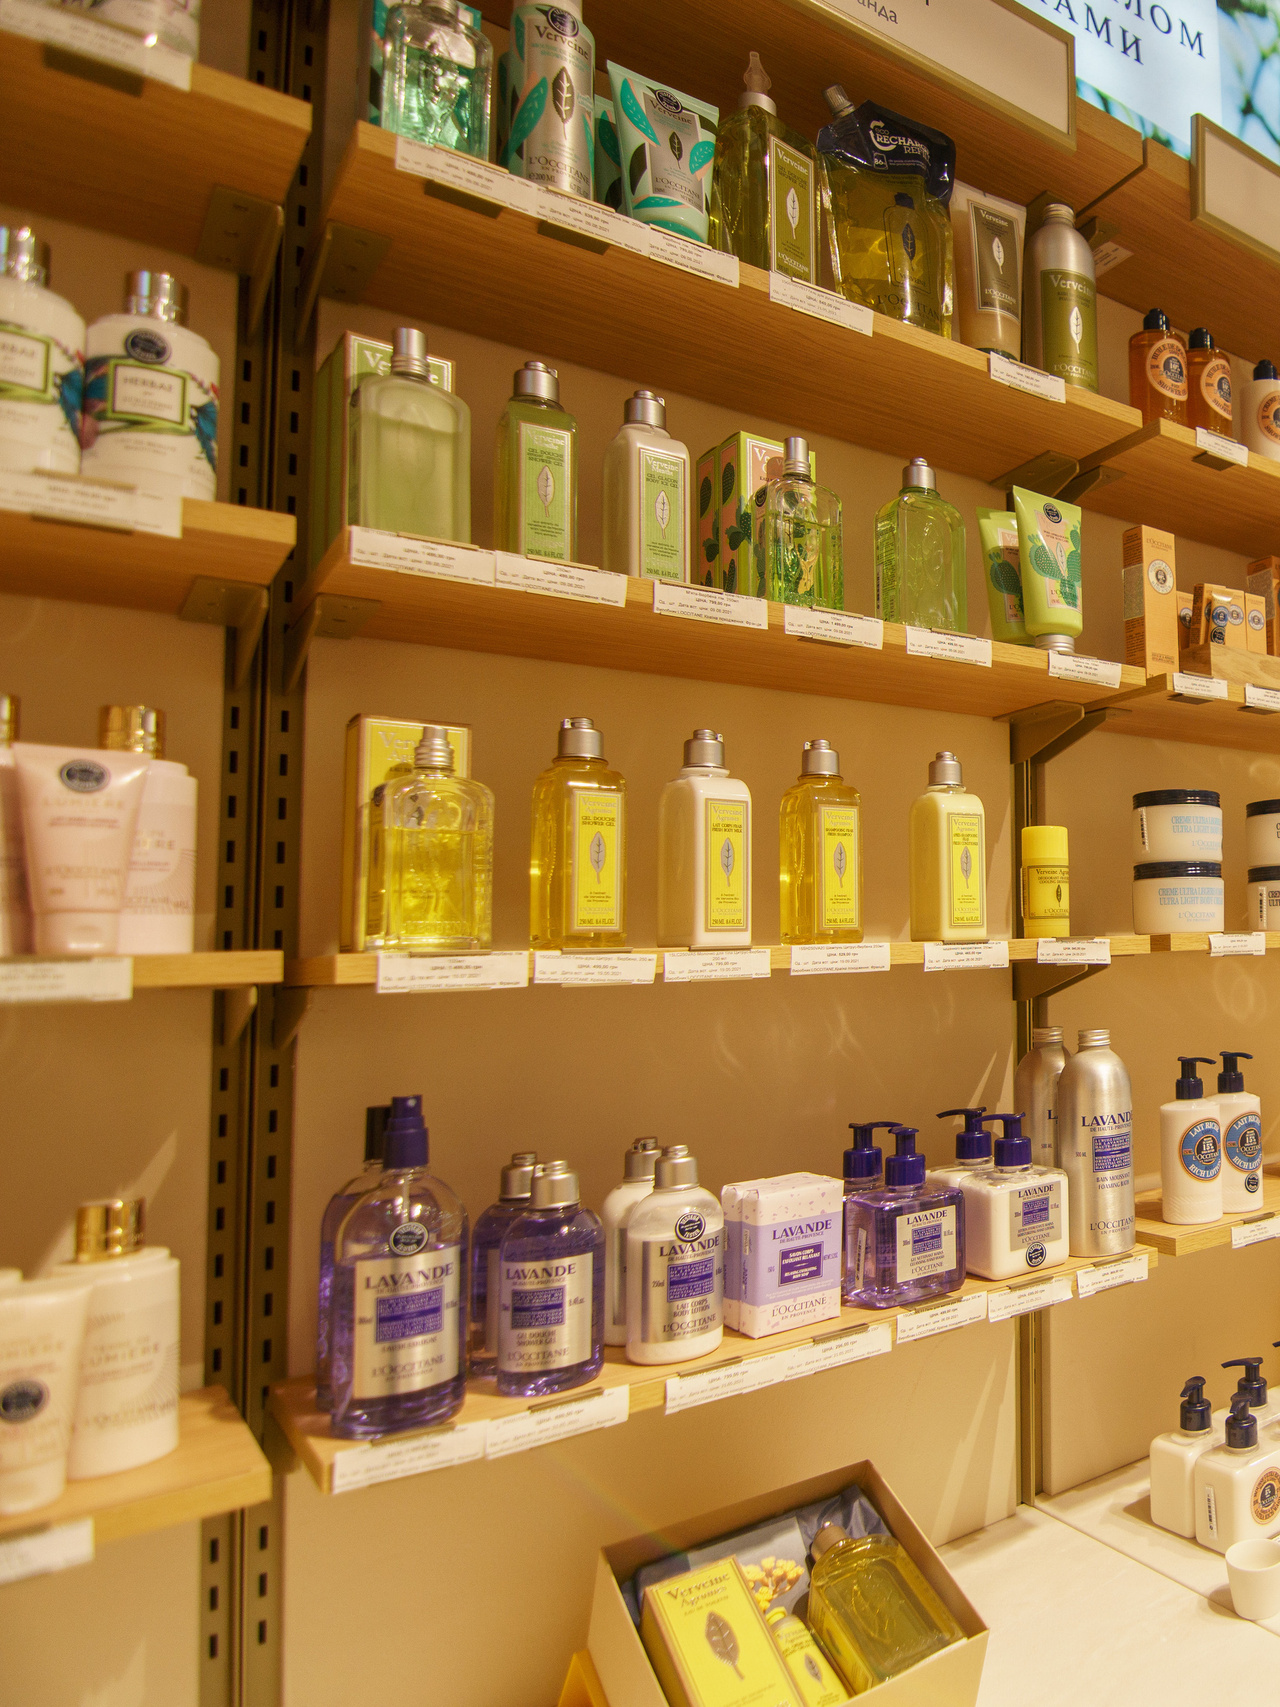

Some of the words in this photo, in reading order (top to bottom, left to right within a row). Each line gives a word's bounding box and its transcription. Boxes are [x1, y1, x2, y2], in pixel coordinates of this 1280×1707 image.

[1040, 0, 1144, 65] АМИ
[1113, 0, 1206, 59] ЛОМ
[535, 23, 589, 61] Verveine
[529, 155, 590, 184] L'OCCITANE
[776, 147, 809, 176] Verveine
[645, 456, 679, 472] Verveine
[581, 798, 617, 810] Verveine
[712, 805, 743, 816] Verveine
[825, 811, 854, 821] Verveine
[953, 818, 979, 828] Verveine
[1036, 868, 1057, 876] Verveine
[1081, 1110, 1133, 1128] LAVAND
[1233, 1116, 1248, 1130] LAIT
[1189, 1122, 1205, 1138] LAIT
[1188, 1163, 1206, 1177] RICH
[1018, 1184, 1054, 1199] LAVANDE
[906, 1210, 948, 1226] LAVANDE
[772, 1219, 832, 1241] LAVANDE
[658, 1235, 720, 1258] LAVANDE
[1022, 1233, 1051, 1244] L'OCCITANE
[364, 1262, 455, 1290] LAVANDE
[505, 1262, 577, 1281] LAVANDE
[911, 1262, 944, 1275] L'OCCITANE
[673, 1308, 689, 1318] BODY
[690, 1304, 710, 1315] LOTION
[676, 1301, 689, 1311] LAIT
[690, 1298, 708, 1307] CORPS
[772, 1297, 827, 1317] L'OCCITANE
[663, 1313, 717, 1334] L'OCCITANE
[506, 1346, 570, 1363] L'OCCITANE
[666, 1572, 730, 1600] Verveine
